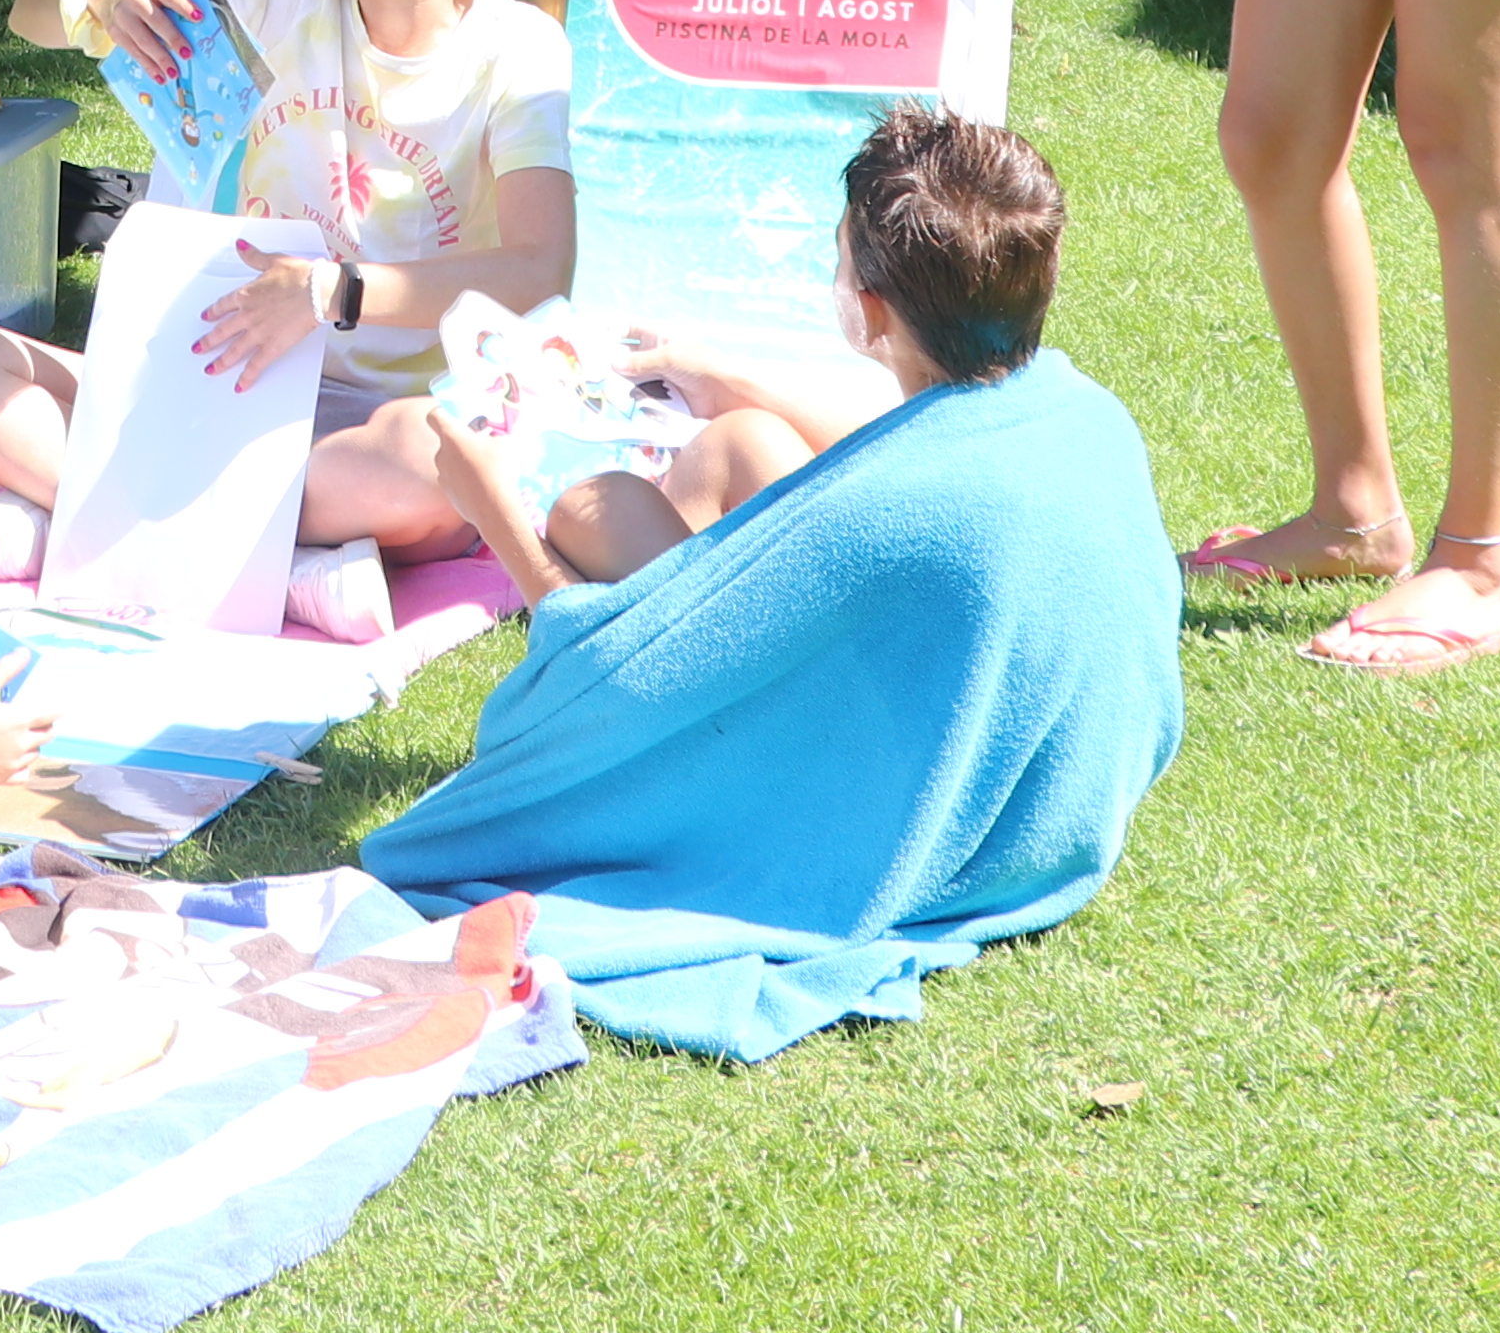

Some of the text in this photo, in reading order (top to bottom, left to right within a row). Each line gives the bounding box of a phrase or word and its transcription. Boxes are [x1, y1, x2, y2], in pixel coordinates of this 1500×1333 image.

[655, 21, 910, 50] PISCINA DE LA MOLA
[252, 91, 308, 149] LET'S
[417, 154, 462, 250] DREAM
[301, 202, 336, 233] YOUR
